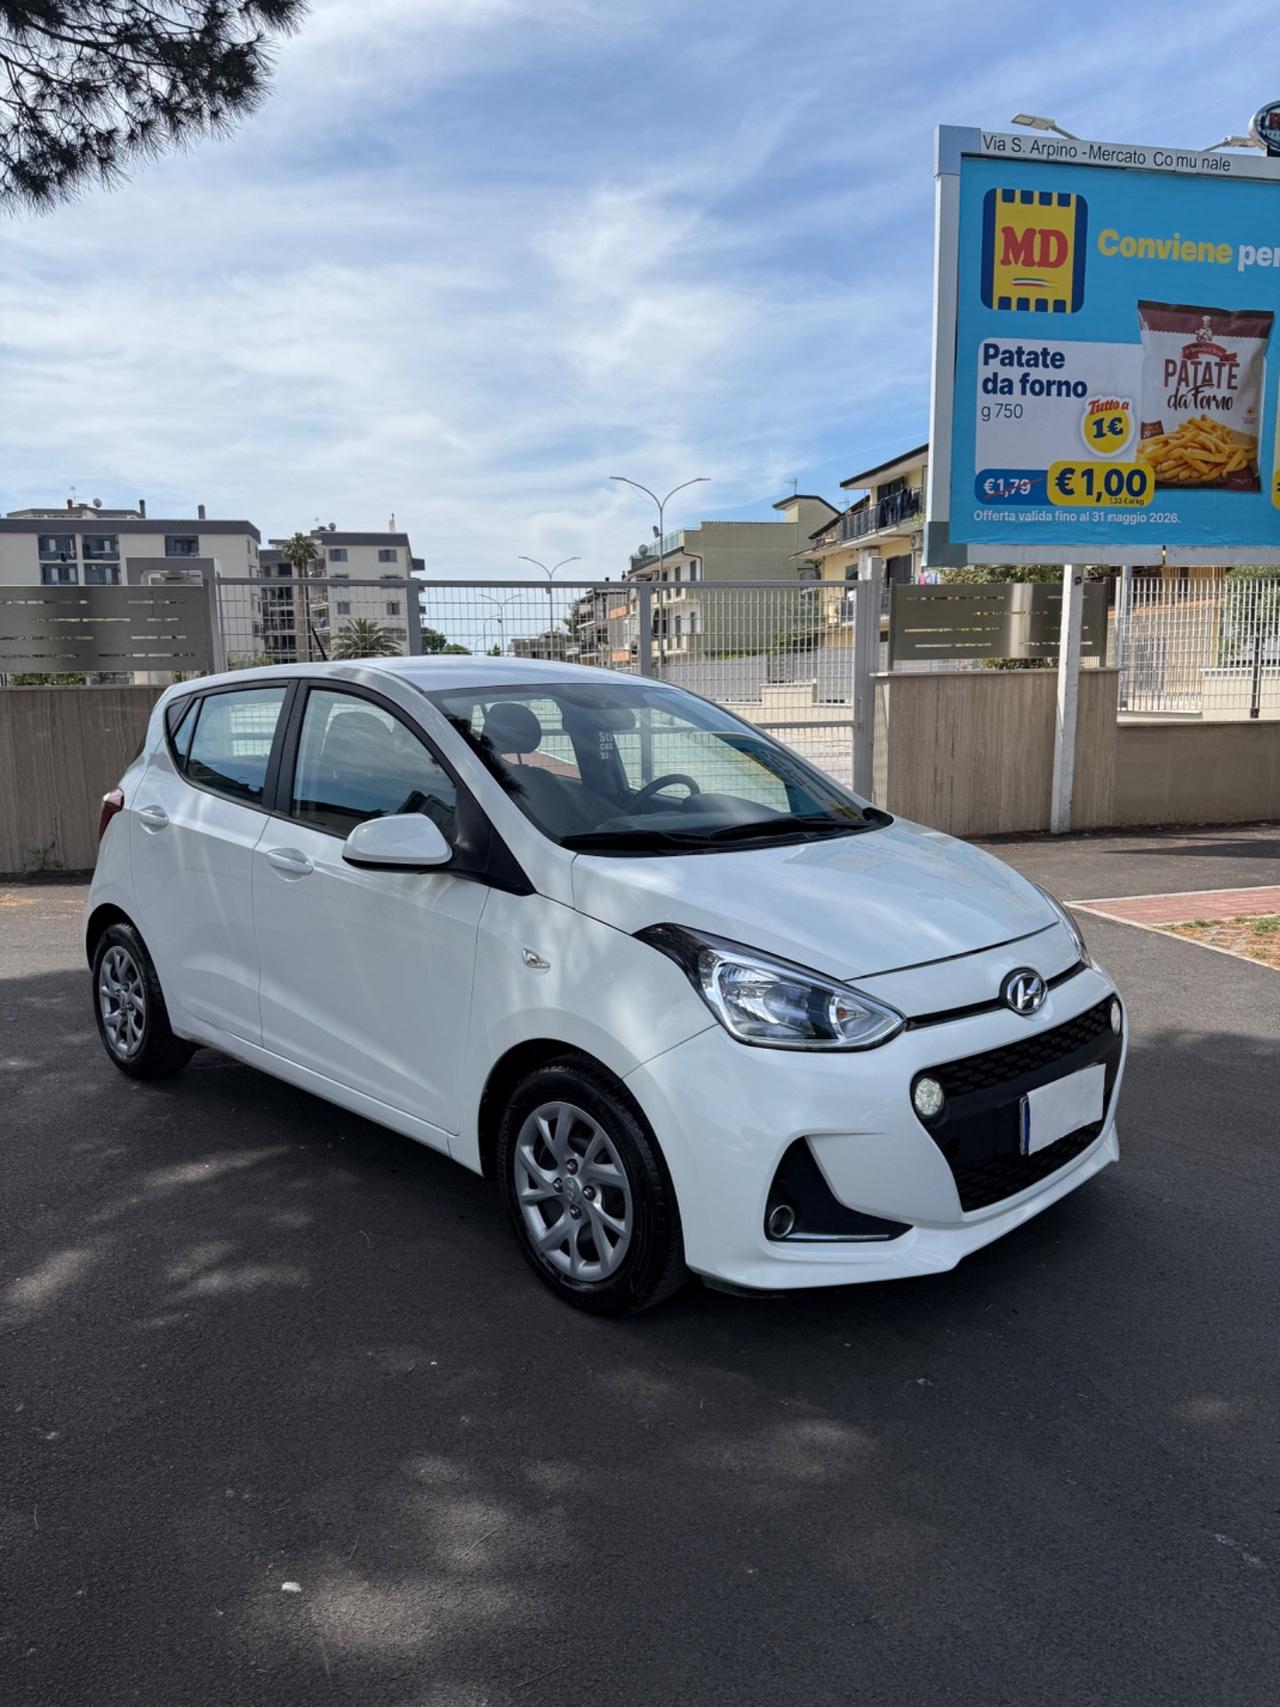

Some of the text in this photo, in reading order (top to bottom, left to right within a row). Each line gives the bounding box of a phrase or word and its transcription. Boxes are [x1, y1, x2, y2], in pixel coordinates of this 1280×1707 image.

[982, 134, 1006, 151] Via
[1011, 137, 1026, 154] S.
[1029, 139, 1078, 158] Arpino
[1000, 226, 1069, 269] MD
[1098, 229, 1233, 265] Conviene
[982, 343, 1066, 369] Patate
[982, 373, 1088, 398] da forno
[1164, 358, 1240, 390] PATATE
[994, 403, 1024, 419] 750
[1088, 399, 1130, 415] Tutto a
[973, 510, 1016, 521] Offerta
[1018, 510, 1052, 521] valida
[1055, 510, 1078, 522] fino
[1079, 511, 1090, 522] al
[1091, 511, 1104, 522] 31
[1107, 511, 1147, 525] maggio
